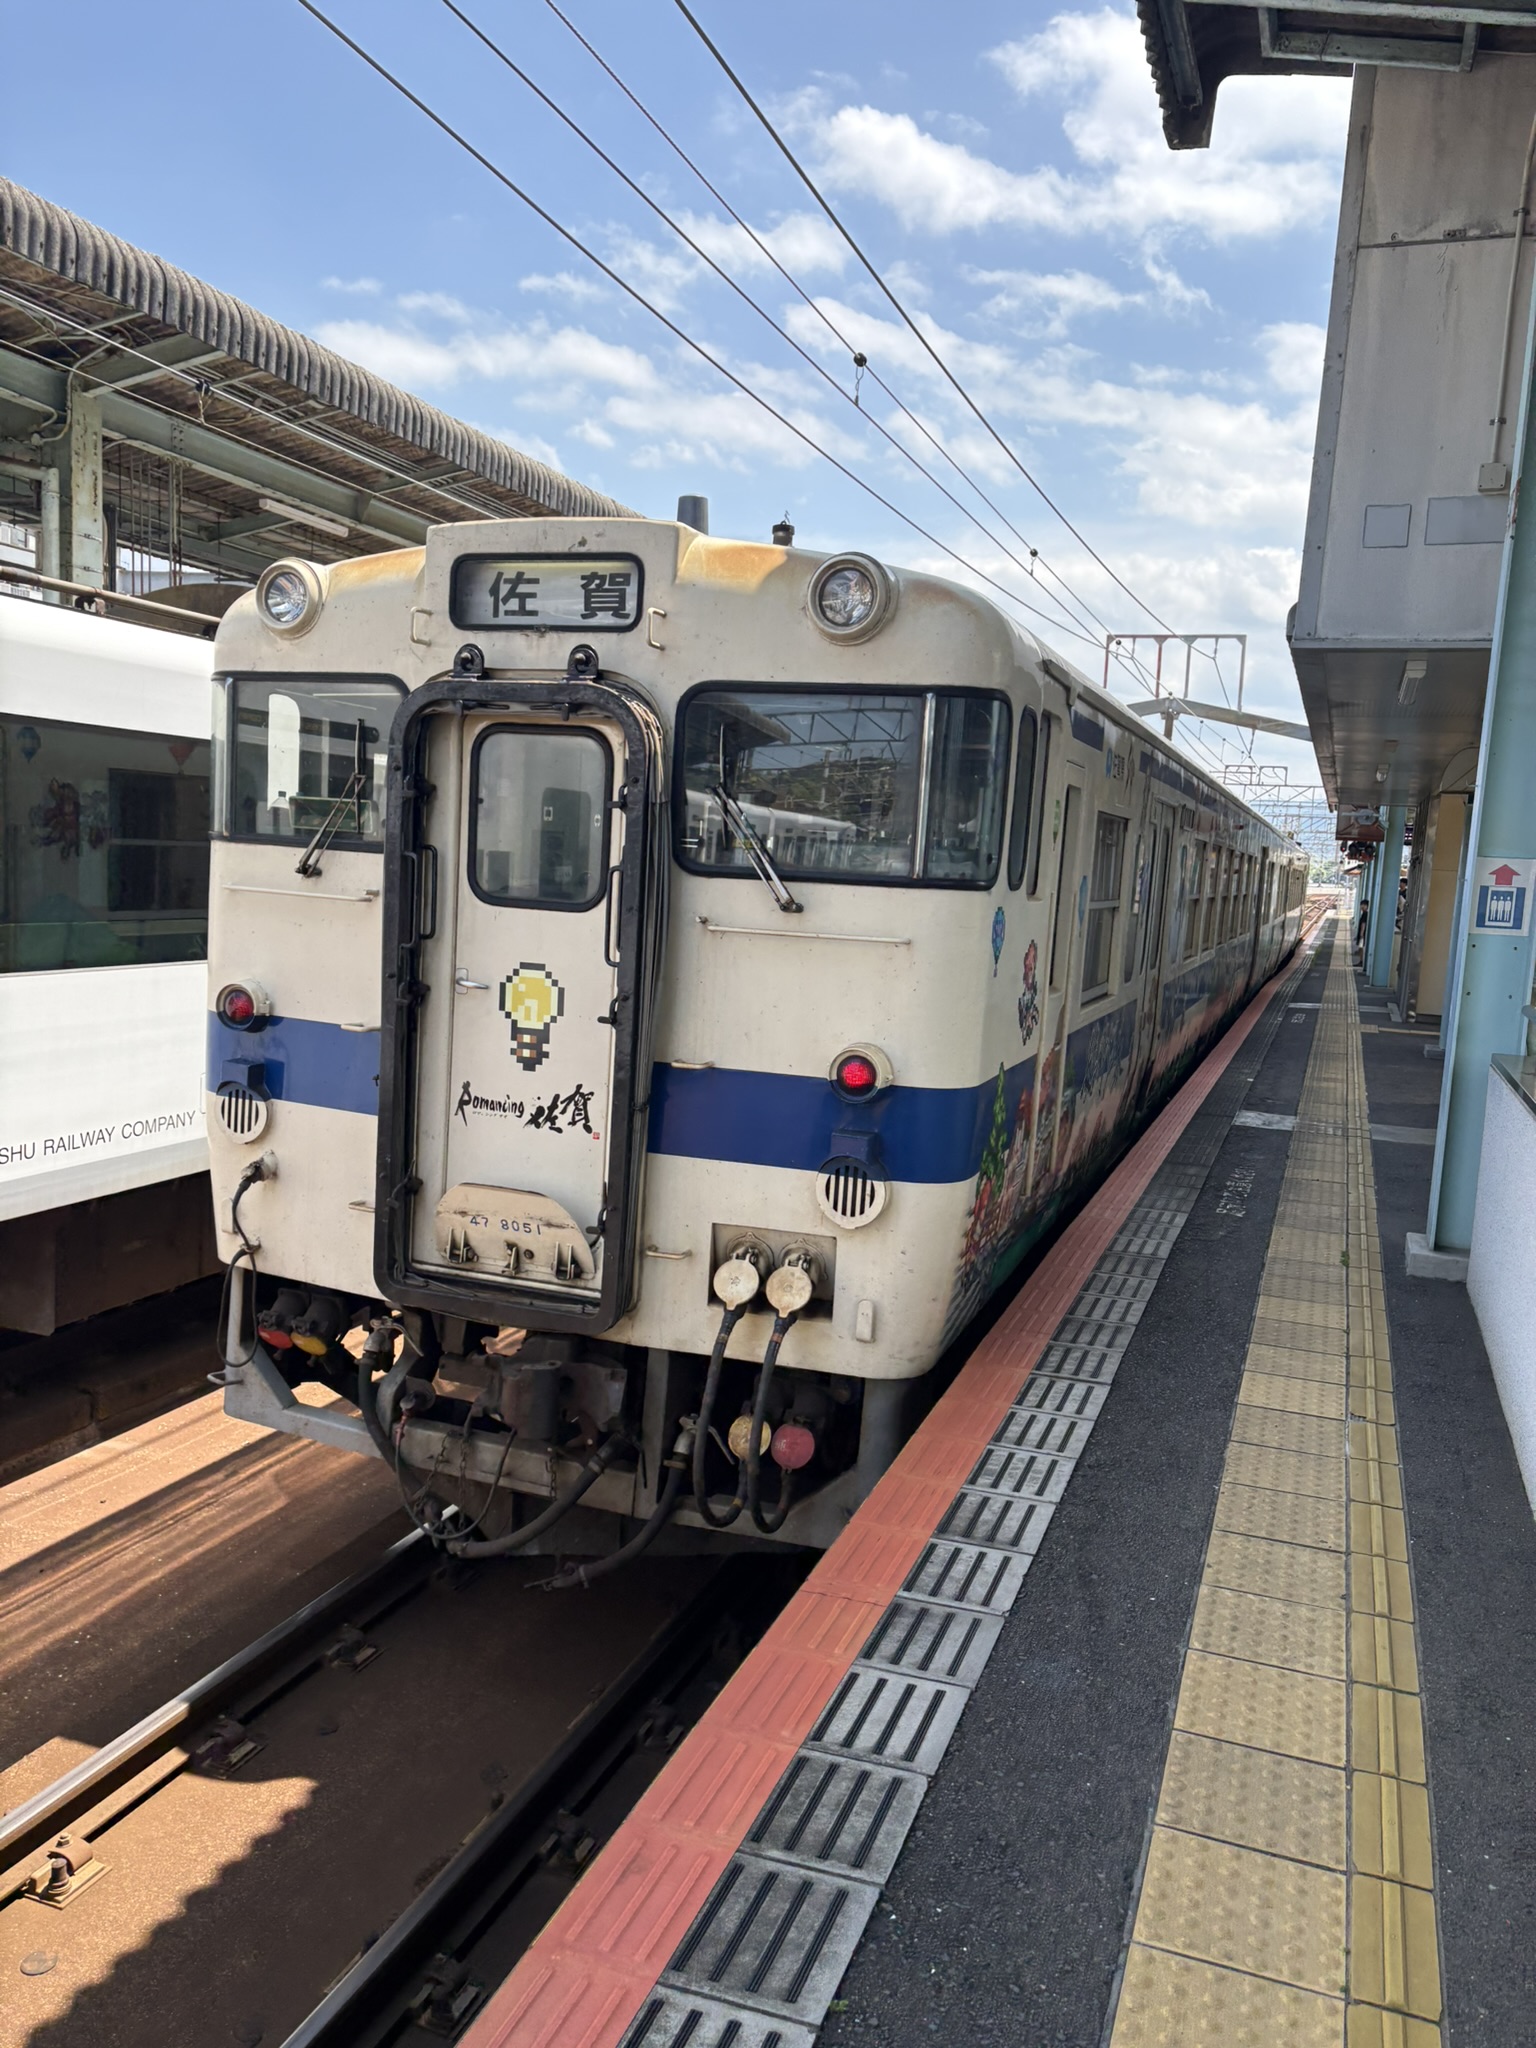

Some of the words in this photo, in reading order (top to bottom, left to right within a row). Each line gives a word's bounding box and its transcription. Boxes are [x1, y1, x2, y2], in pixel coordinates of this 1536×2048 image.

[488, 571, 632, 620] 佐賀
[454, 1081, 525, 1127] Romancing
[523, 1083, 595, 1135] 佐賀
[43, 1126, 116, 1156] RAILWAY
[121, 1110, 196, 1139] COMPANY
[469, 1215, 489, 1228] 47
[500, 1219, 541, 1235] 8051
